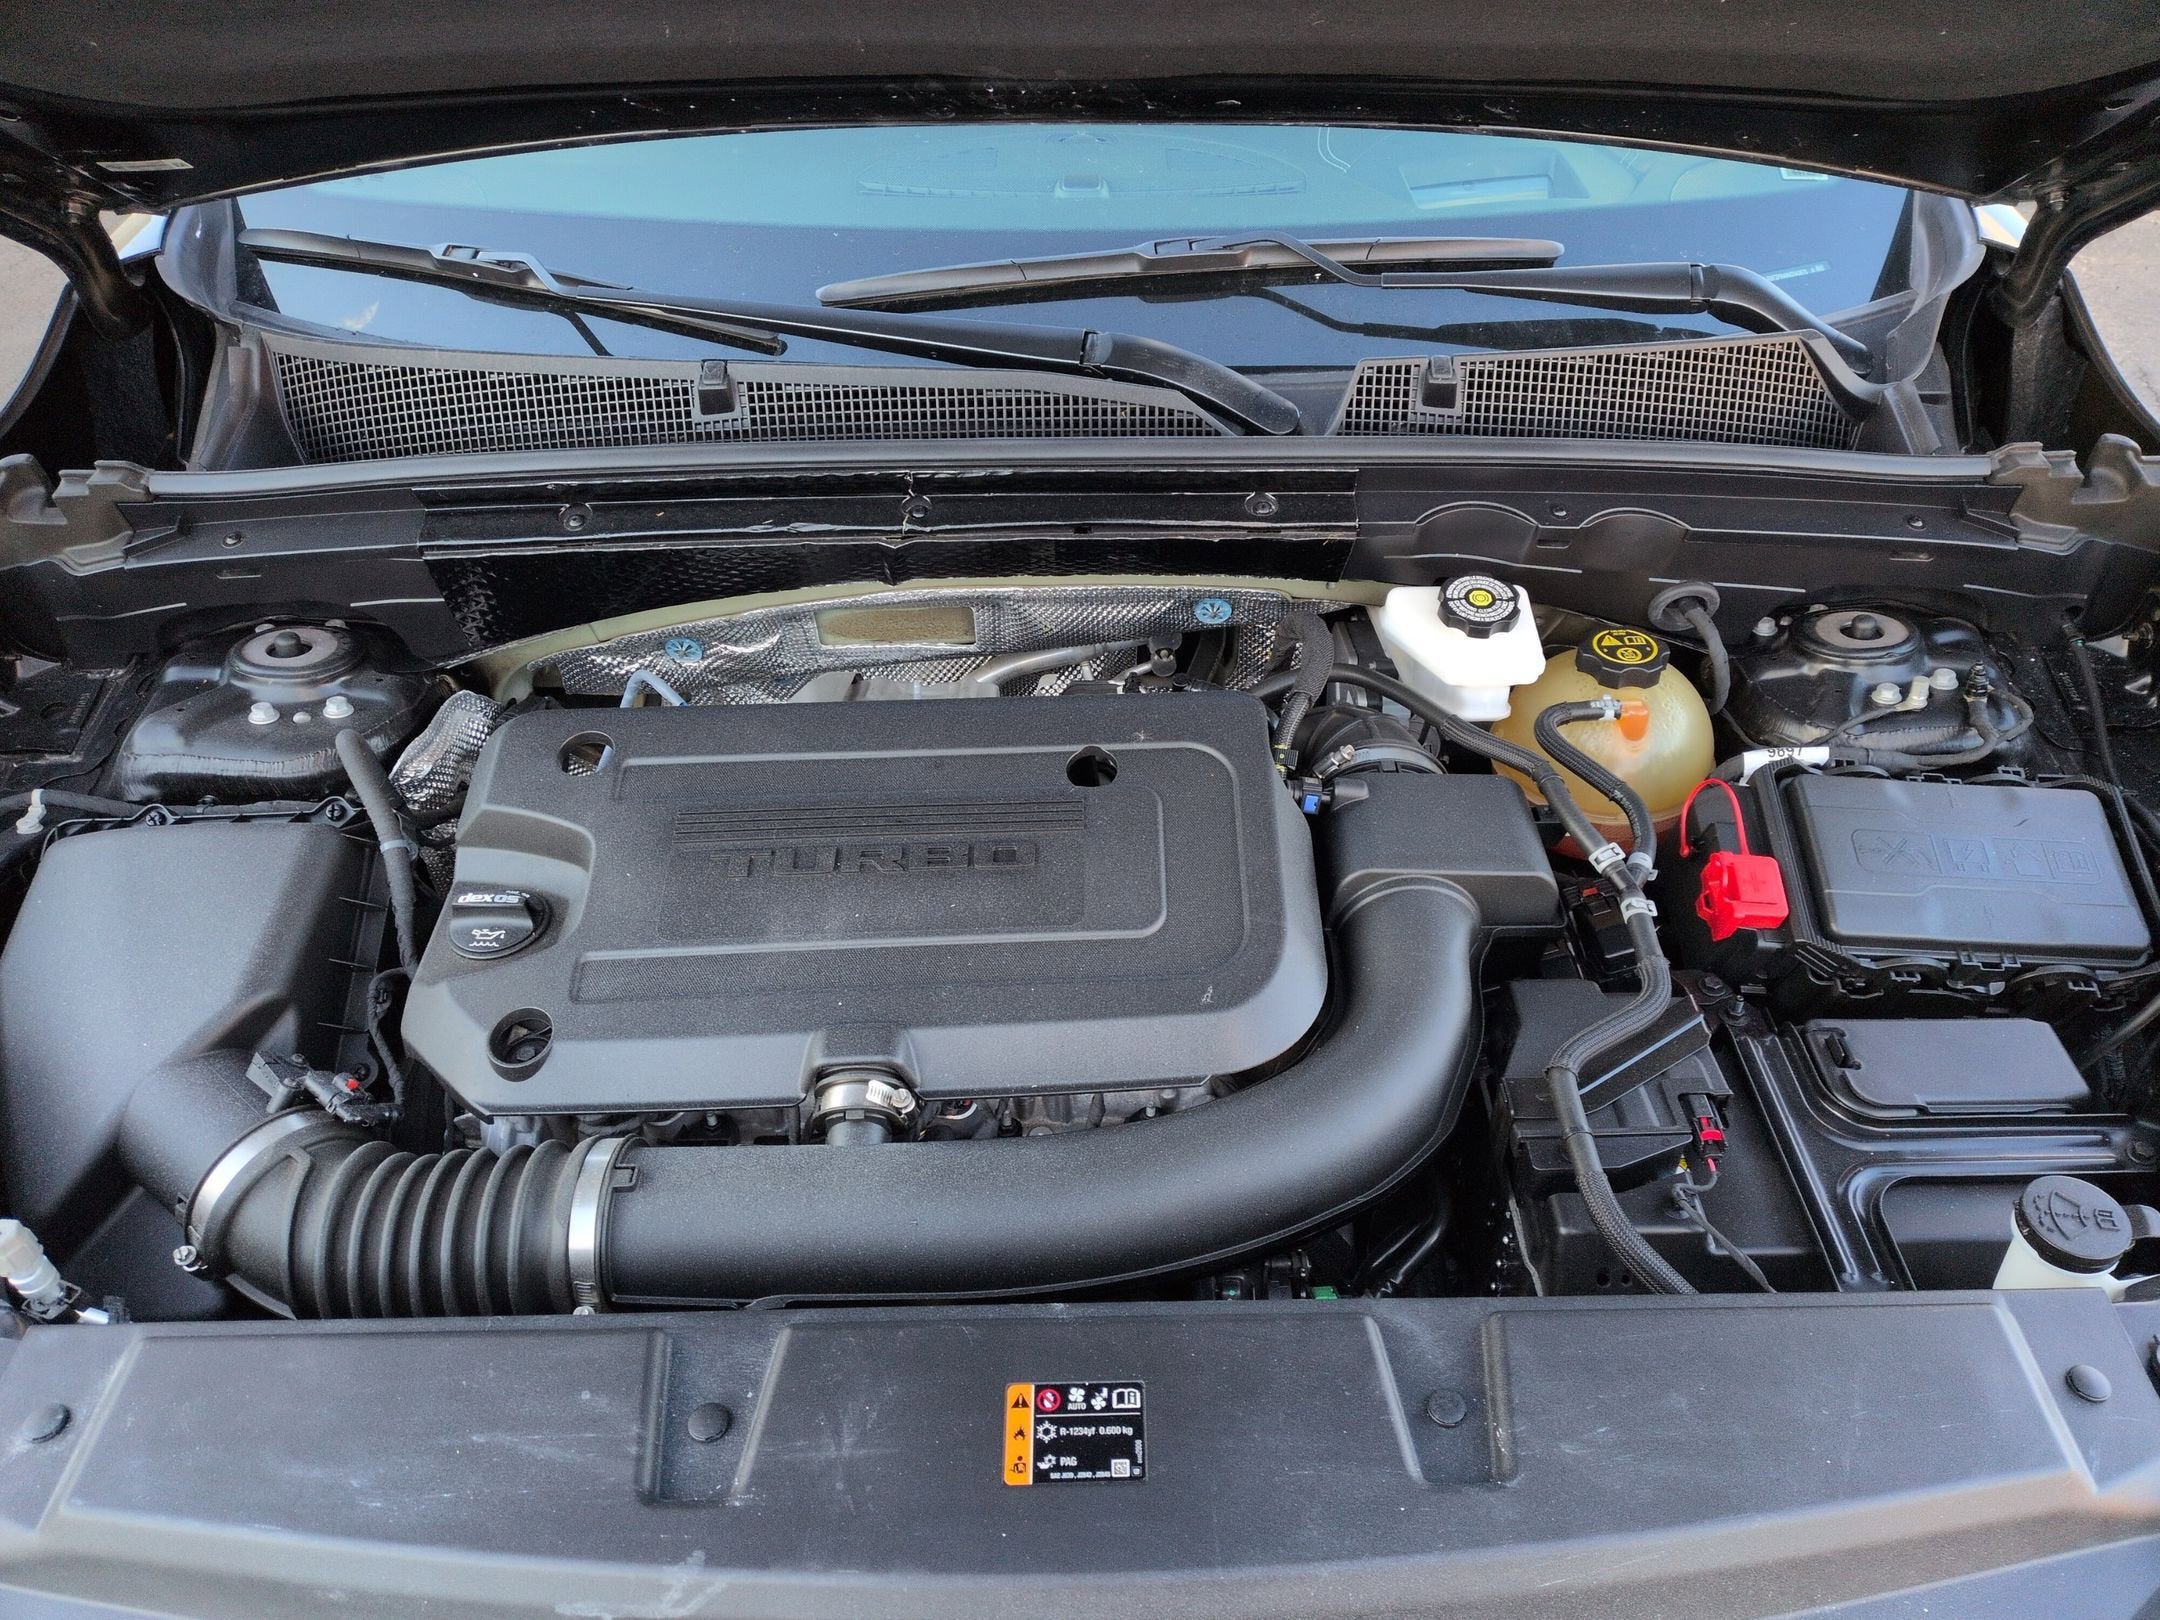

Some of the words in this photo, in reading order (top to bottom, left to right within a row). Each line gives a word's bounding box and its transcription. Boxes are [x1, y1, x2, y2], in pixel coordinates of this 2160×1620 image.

[709, 842, 1038, 878] TURBO
[458, 893, 519, 903] dexos
[1067, 1402, 1087, 1410] AUTO
[1122, 1426, 1133, 1436] kg
[1060, 1456, 1077, 1467] PAG
